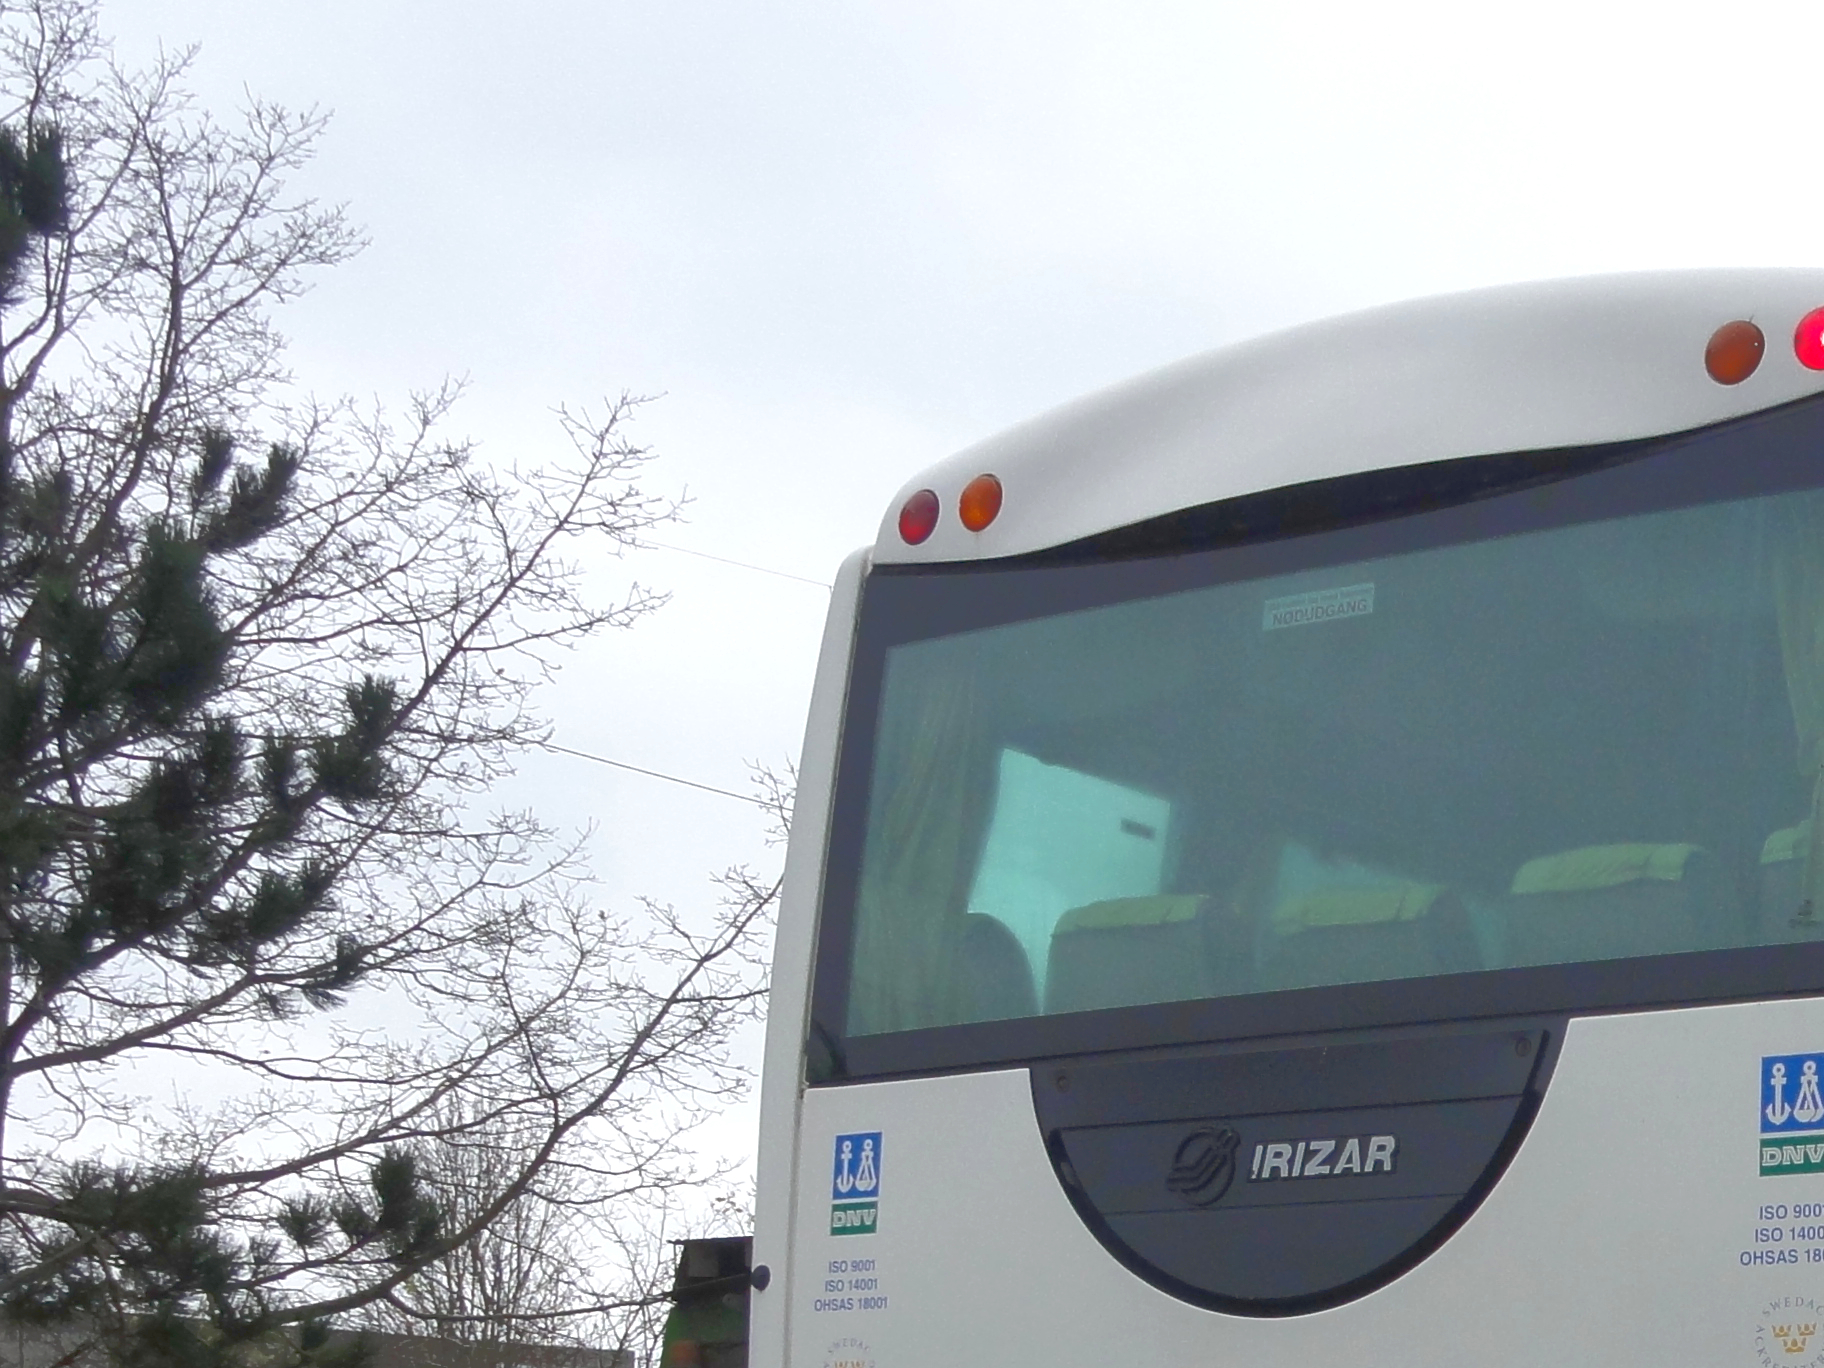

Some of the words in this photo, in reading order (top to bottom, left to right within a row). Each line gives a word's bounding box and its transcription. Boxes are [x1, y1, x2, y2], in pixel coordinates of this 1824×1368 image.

[1272, 599, 1367, 626] NØDUDGANG
[1252, 1135, 1396, 1180] IRIZAR
[832, 1209, 876, 1227] DNV
[1758, 1205, 1788, 1221] ISO
[1754, 1228, 1784, 1243] ISO
[1740, 1250, 1799, 1266] OHSAS
[828, 1261, 849, 1274] ISO
[851, 1259, 876, 1273] 9001
[824, 1280, 845, 1293] ISO
[848, 1278, 878, 1292] 14001
[813, 1298, 855, 1312] OHSAS
[857, 1296, 888, 1311] 18001
